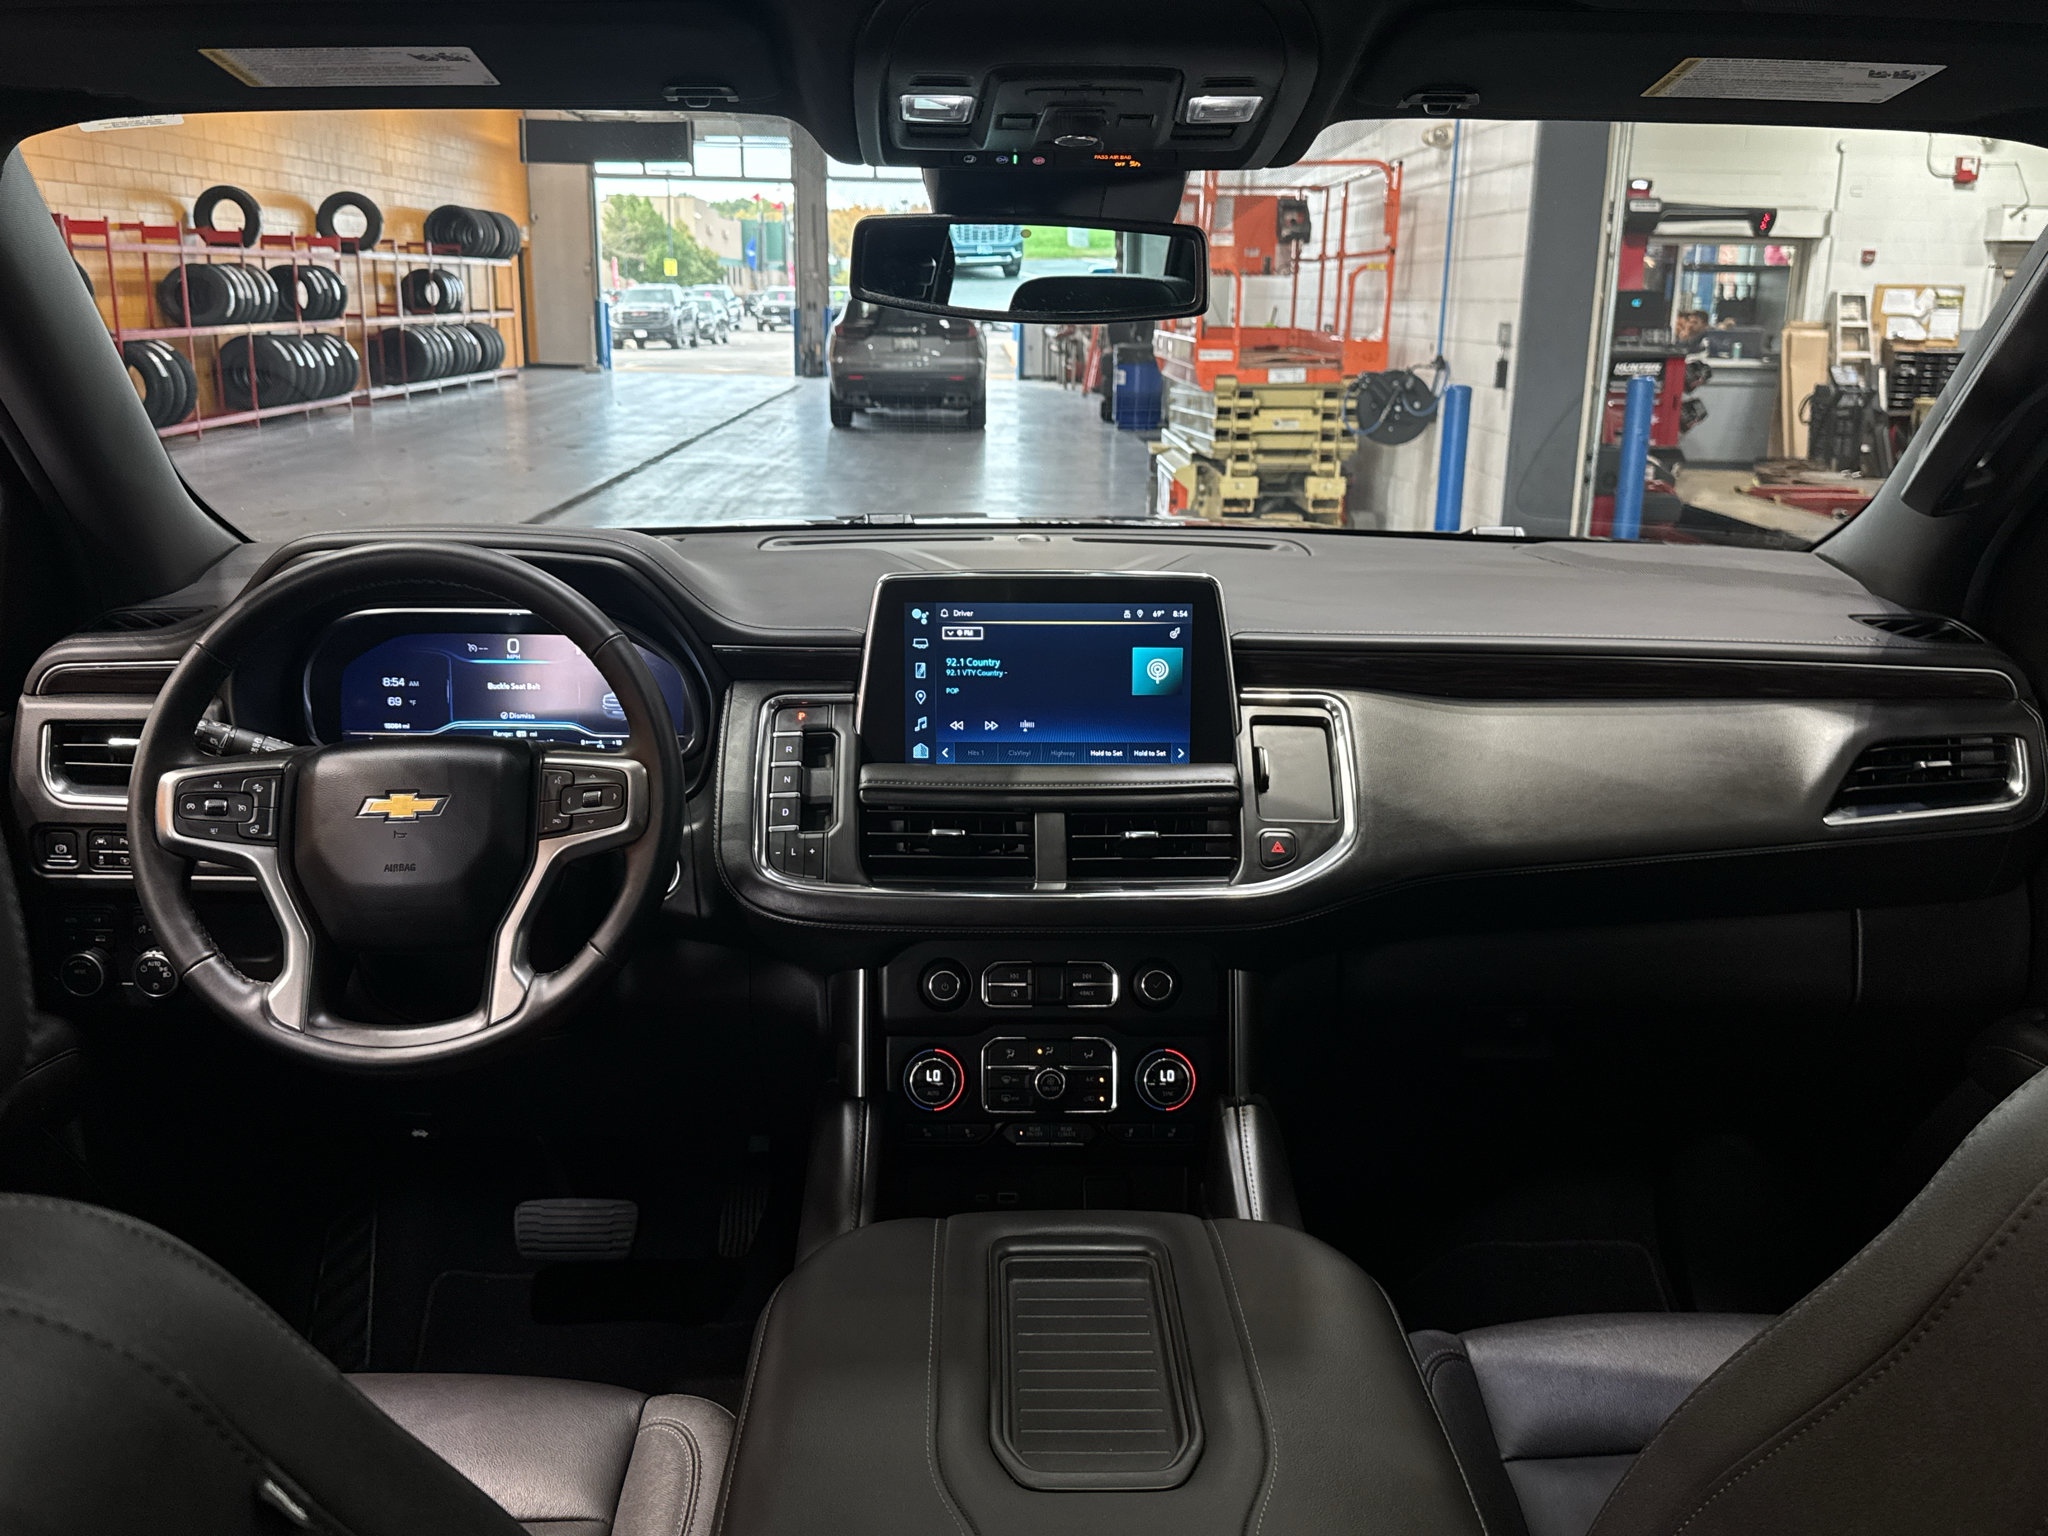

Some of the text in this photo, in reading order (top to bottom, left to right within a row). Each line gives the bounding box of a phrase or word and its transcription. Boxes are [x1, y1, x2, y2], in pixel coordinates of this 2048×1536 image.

[953, 609, 974, 617] Driver
[1172, 610, 1188, 618] 8:54
[506, 637, 520, 654] 0
[945, 657, 1001, 669] 92.1 Country
[945, 669, 961, 677] 92.1
[962, 669, 976, 677] VTY
[977, 669, 1004, 678] Country
[382, 677, 405, 687] 8:54
[487, 682, 541, 690] Buckle Seat Belt
[387, 696, 402, 706] 69
[797, 712, 806, 720] P
[785, 746, 793, 754] R
[1050, 749, 1076, 758] Highway
[1090, 749, 1105, 757] Hold
[1112, 749, 1123, 757] Set
[1133, 749, 1148, 757] Hold
[1156, 749, 1167, 757] Set
[783, 775, 791, 783] N
[781, 808, 789, 816] D
[790, 848, 797, 856] L
[384, 863, 416, 872] AIRBAG
[926, 1070, 942, 1082] LO
[1159, 1070, 1175, 1082] LO
